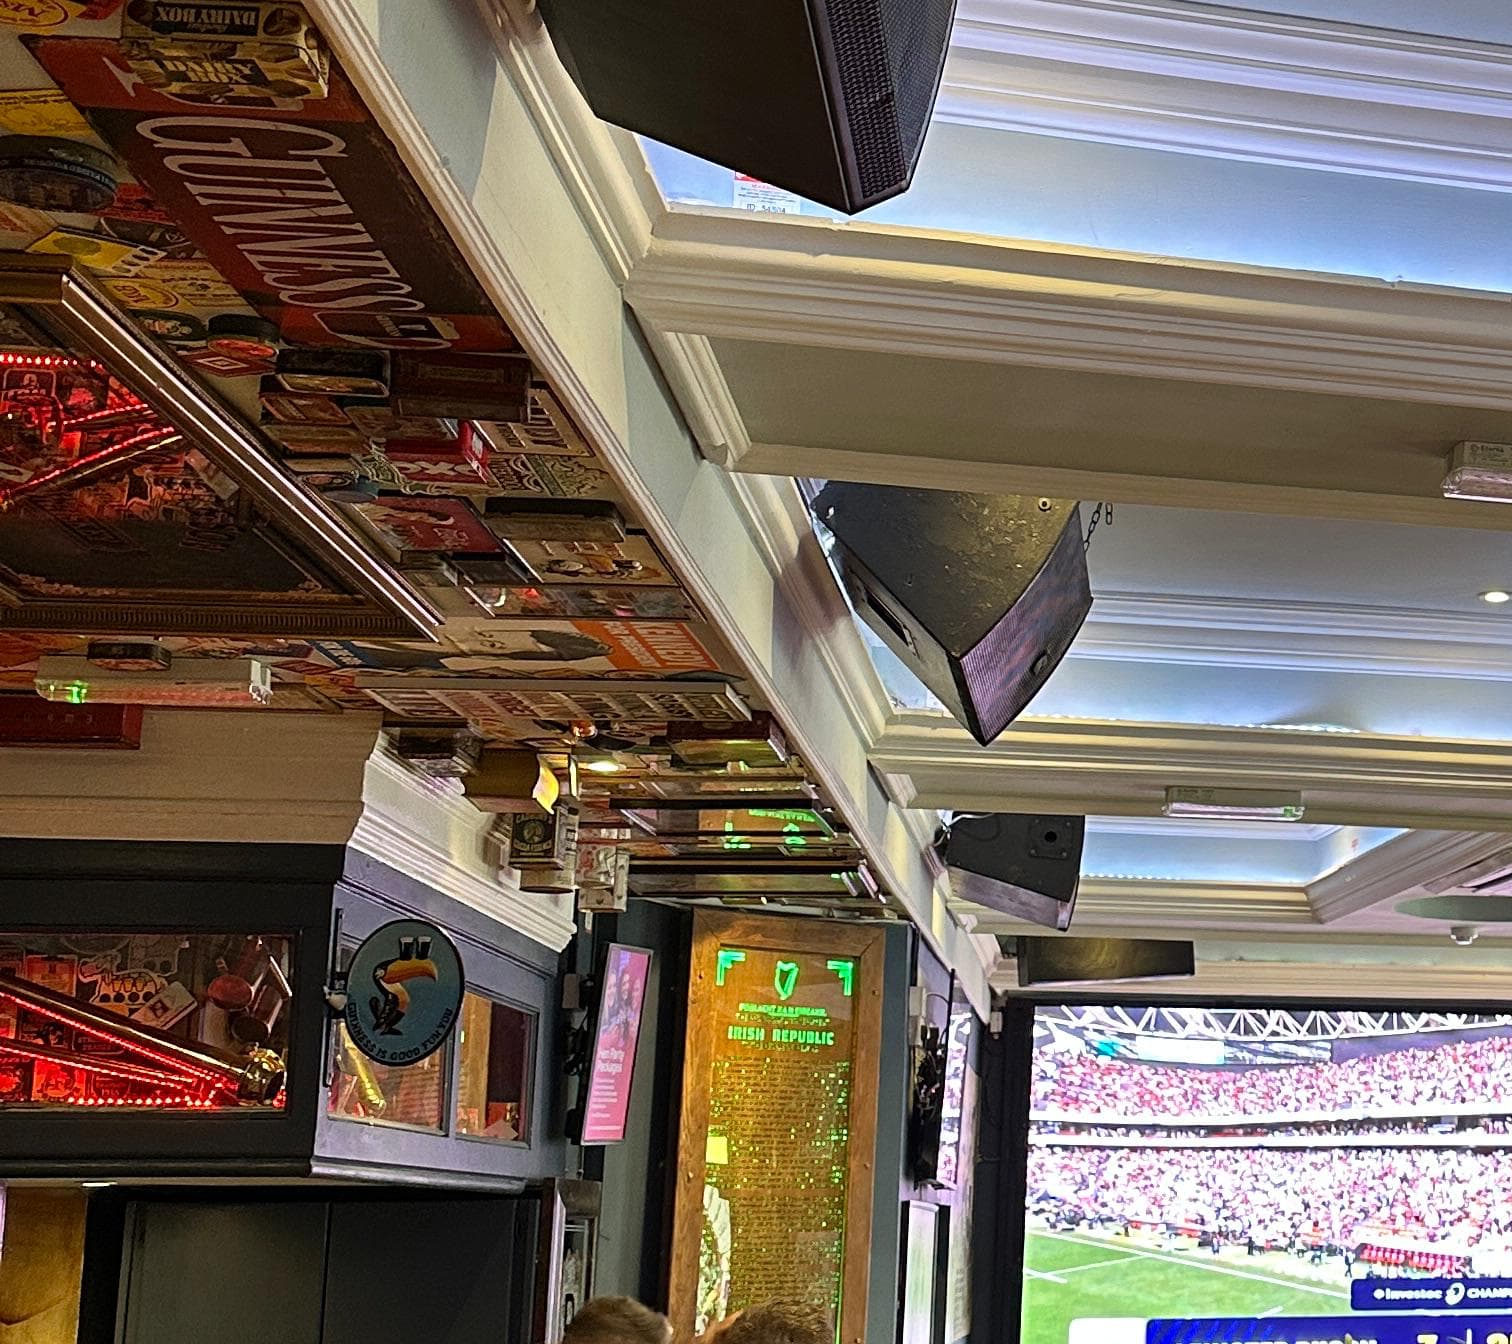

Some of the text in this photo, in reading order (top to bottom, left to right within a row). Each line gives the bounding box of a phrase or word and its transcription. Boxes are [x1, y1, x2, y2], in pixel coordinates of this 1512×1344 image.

[155, 4, 258, 28] DAIRY BOX
[136, 116, 426, 317] GUINNESS
[629, 622, 710, 668] KENNEDY
[346, 1002, 377, 1054] GUINNESS
[389, 1046, 422, 1062] GOOD
[436, 1007, 454, 1034] YOU
[727, 1024, 835, 1047] IRISH REPUBLIC
